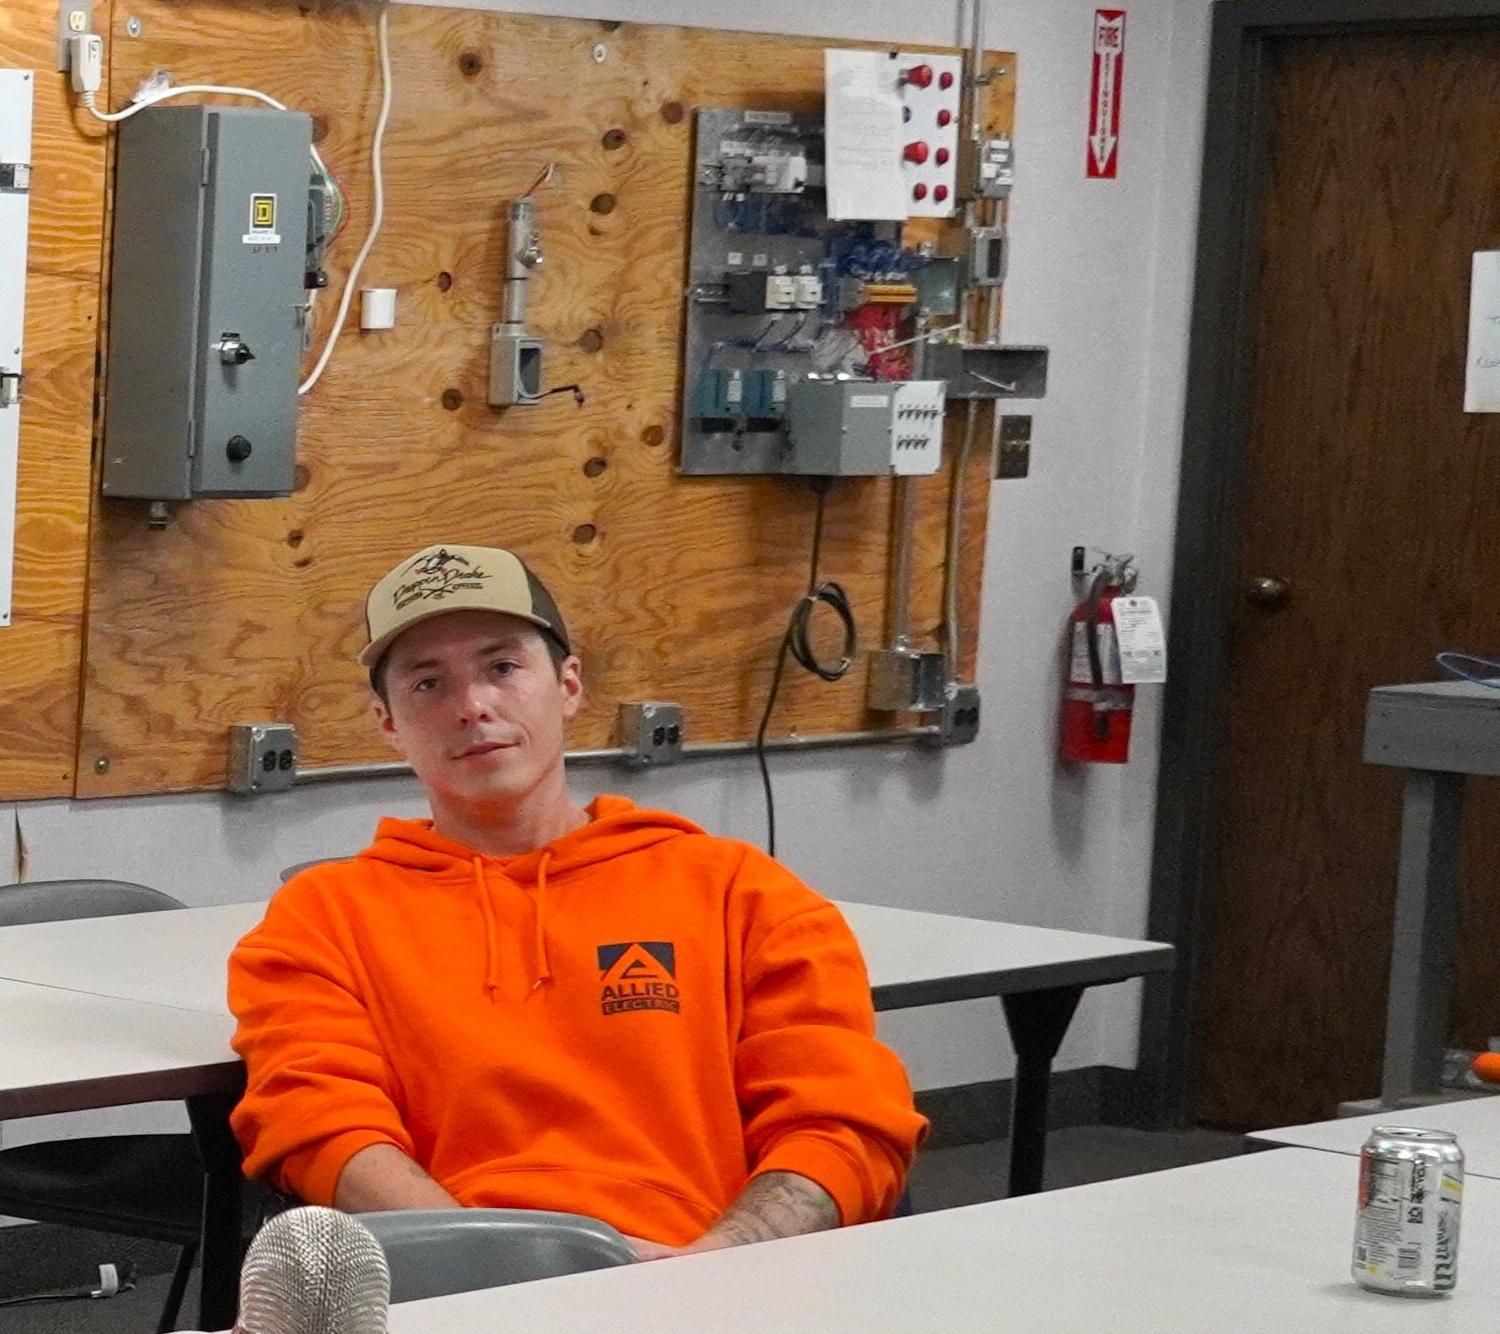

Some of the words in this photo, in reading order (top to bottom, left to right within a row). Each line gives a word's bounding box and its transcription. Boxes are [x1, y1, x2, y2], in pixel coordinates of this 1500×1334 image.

[1099, 26, 1119, 47] FIRE
[601, 982, 680, 1002] ALLIED
[603, 997, 680, 1015] ELECTRIC
